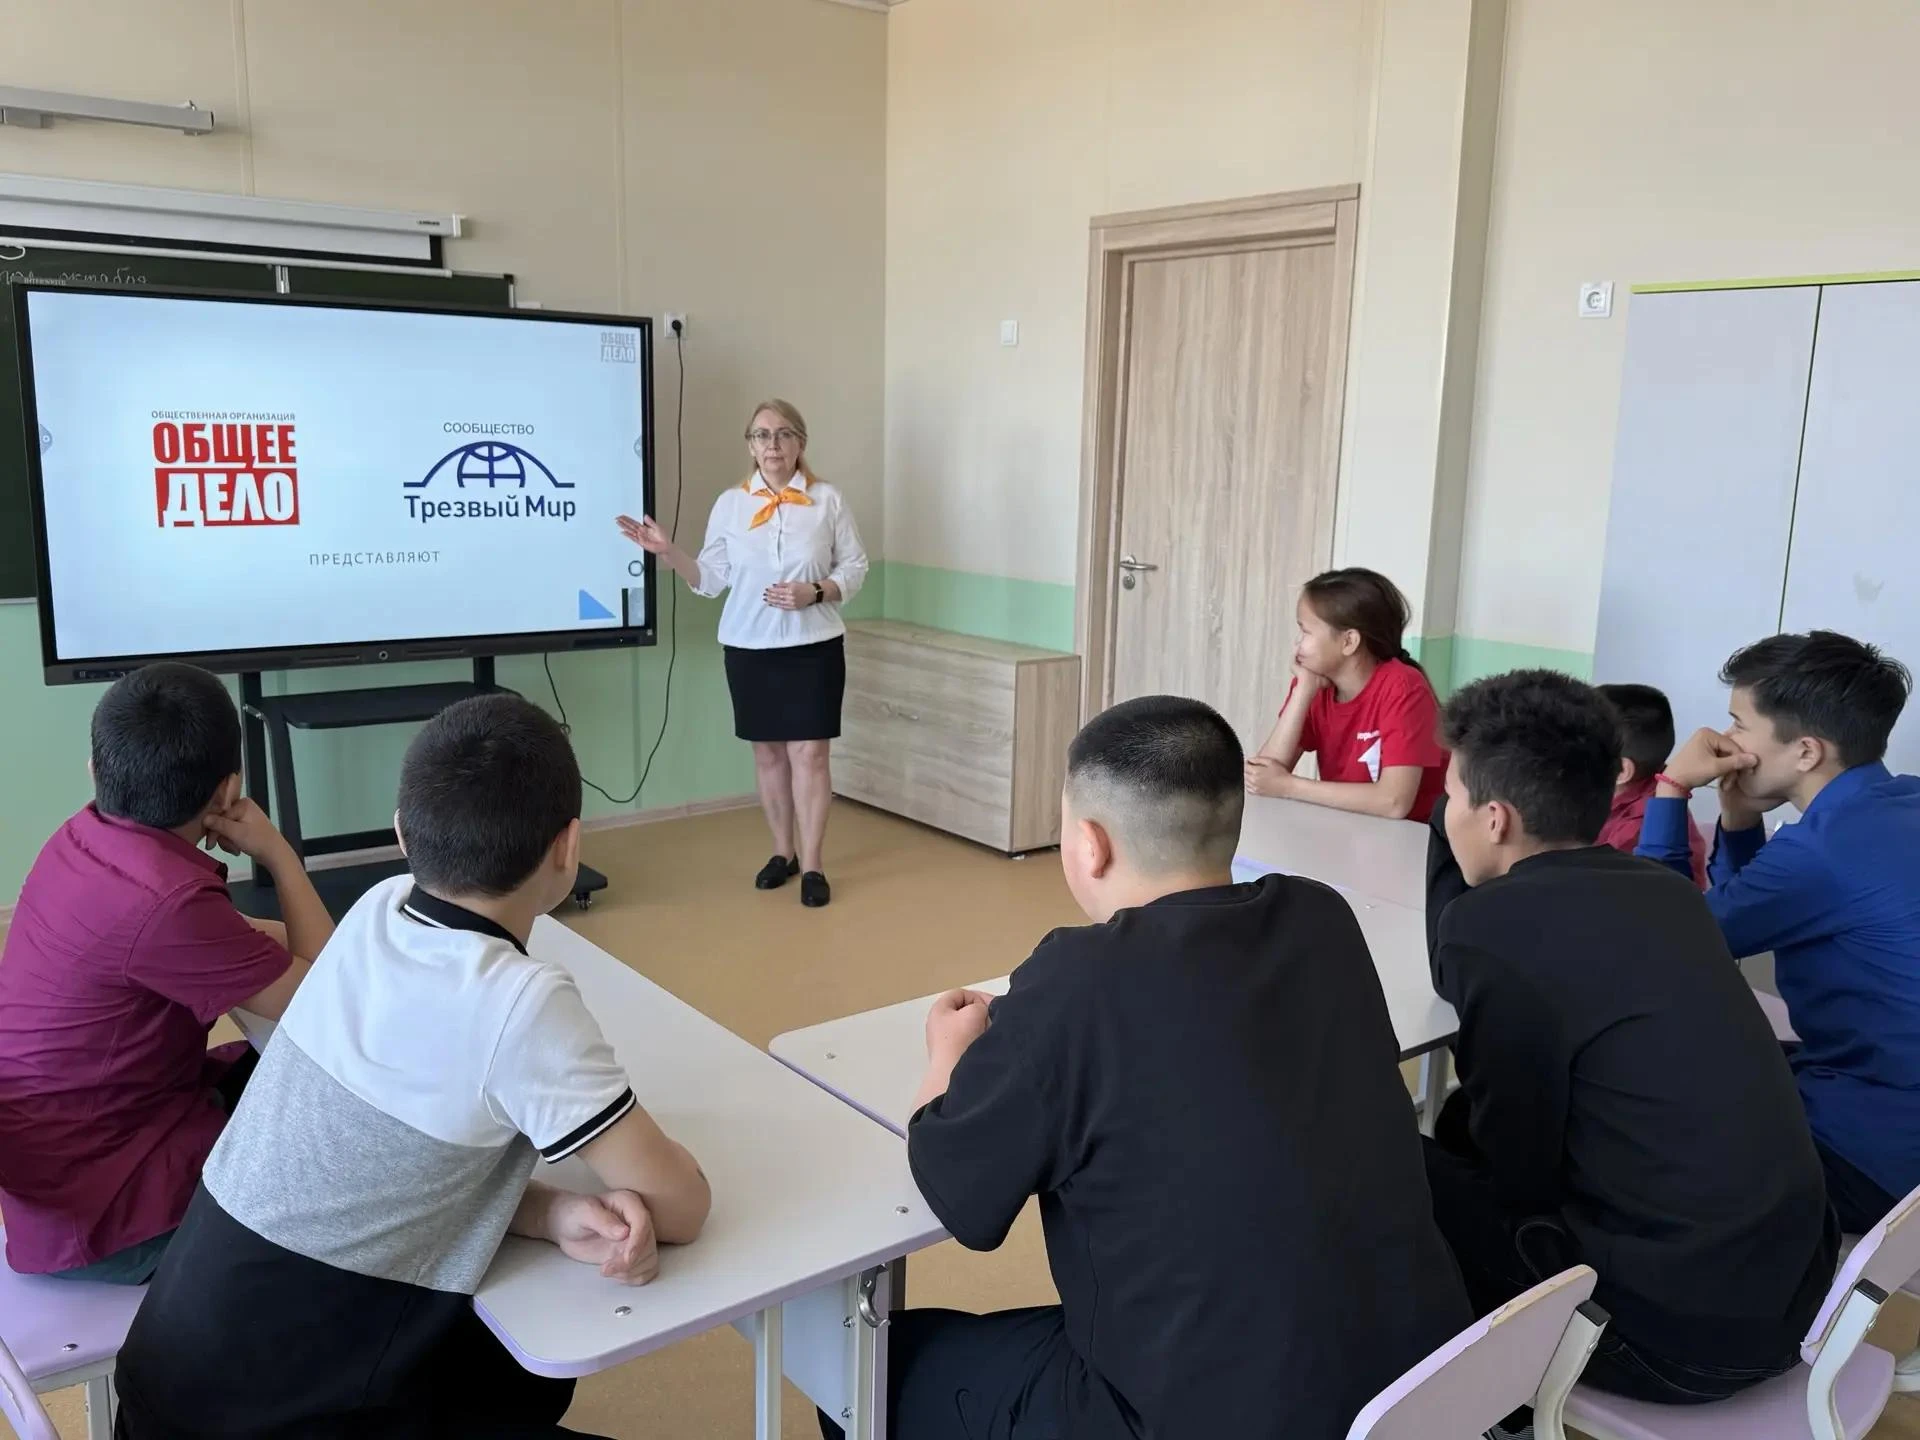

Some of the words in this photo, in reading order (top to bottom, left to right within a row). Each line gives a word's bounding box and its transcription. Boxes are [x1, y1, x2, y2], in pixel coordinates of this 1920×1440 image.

[601, 345, 636, 363] ДЕЛО
[151, 410, 228, 421] ОБЩЕСТВЕННАЯ
[229, 411, 296, 422] ОРГАНИЗАЦИЯ
[443, 422, 535, 435] СООБЩЕСТВО
[153, 421, 297, 465] ОБЩЕЕ
[160, 471, 297, 527] ДЕЛО
[403, 495, 519, 523] Трезвый
[525, 495, 577, 522] Мир
[308, 551, 441, 567] ПРЕДСТАВЛЯЮТ
